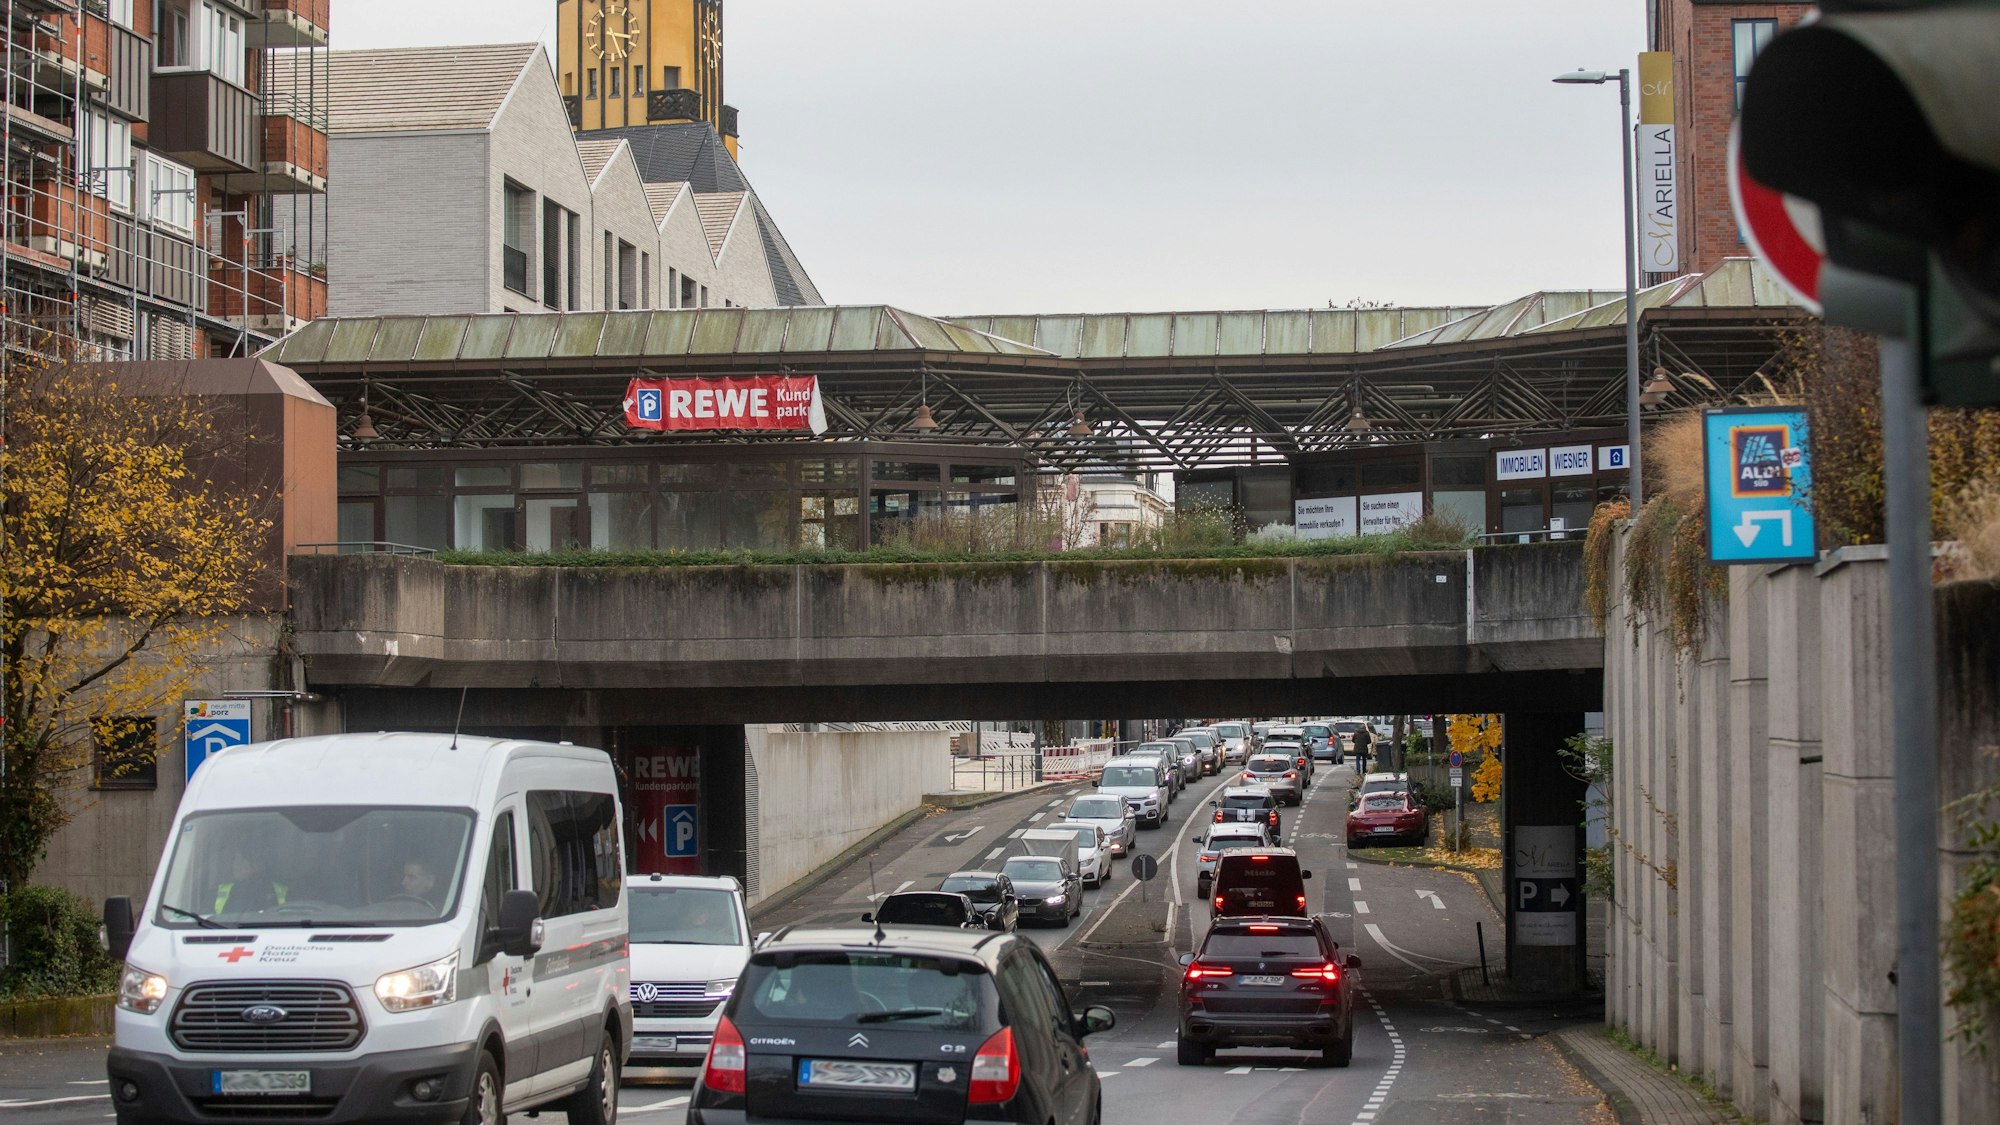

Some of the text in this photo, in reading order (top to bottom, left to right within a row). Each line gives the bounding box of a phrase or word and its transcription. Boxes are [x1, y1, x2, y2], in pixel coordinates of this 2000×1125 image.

[1647, 127, 1675, 267] MARIELLA
[669, 389, 769, 419] REWE
[1500, 451, 1589, 474] IMMOBILIEN WIESNER
[1754, 479, 1769, 487] SÜD
[1297, 504, 1334, 515] Sie möchten Ihre
[1362, 500, 1400, 511] Sie suchen einen
[1298, 520, 1319, 530] Immobilie
[1319, 519, 1341, 529] verkaufen
[1362, 516, 1384, 526] Verwalter
[1384, 515, 1392, 525] für
[228, 702, 246, 710] mitte
[635, 756, 700, 778] REWE
[1244, 869, 1277, 877] Miele
[1519, 881, 1538, 909] P
[749, 1037, 796, 1046] CITROËN
[940, 1044, 967, 1053] C2
